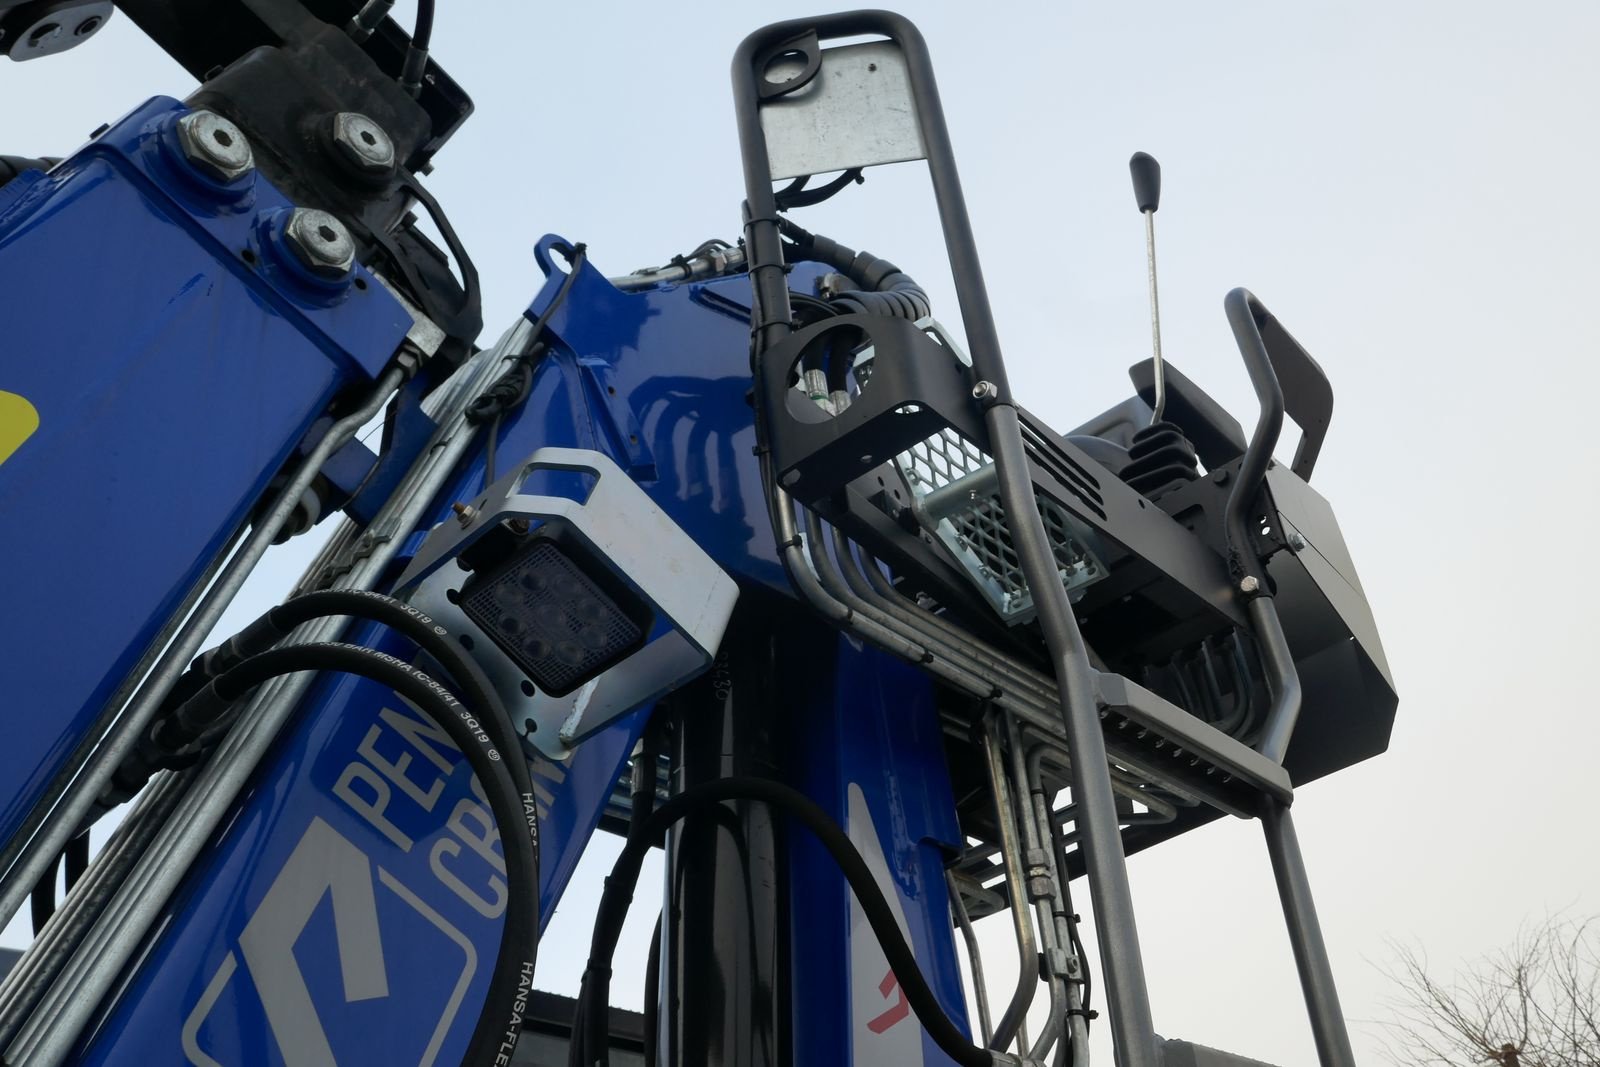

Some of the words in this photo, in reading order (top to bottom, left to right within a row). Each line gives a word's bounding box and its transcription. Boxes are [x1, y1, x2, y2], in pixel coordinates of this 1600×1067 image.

[411, 667, 461, 707] IC-84/41
[460, 711, 490, 743] 3Q19
[332, 670, 464, 853] PEN
[494, 962, 533, 1067] HANSA-FLE
